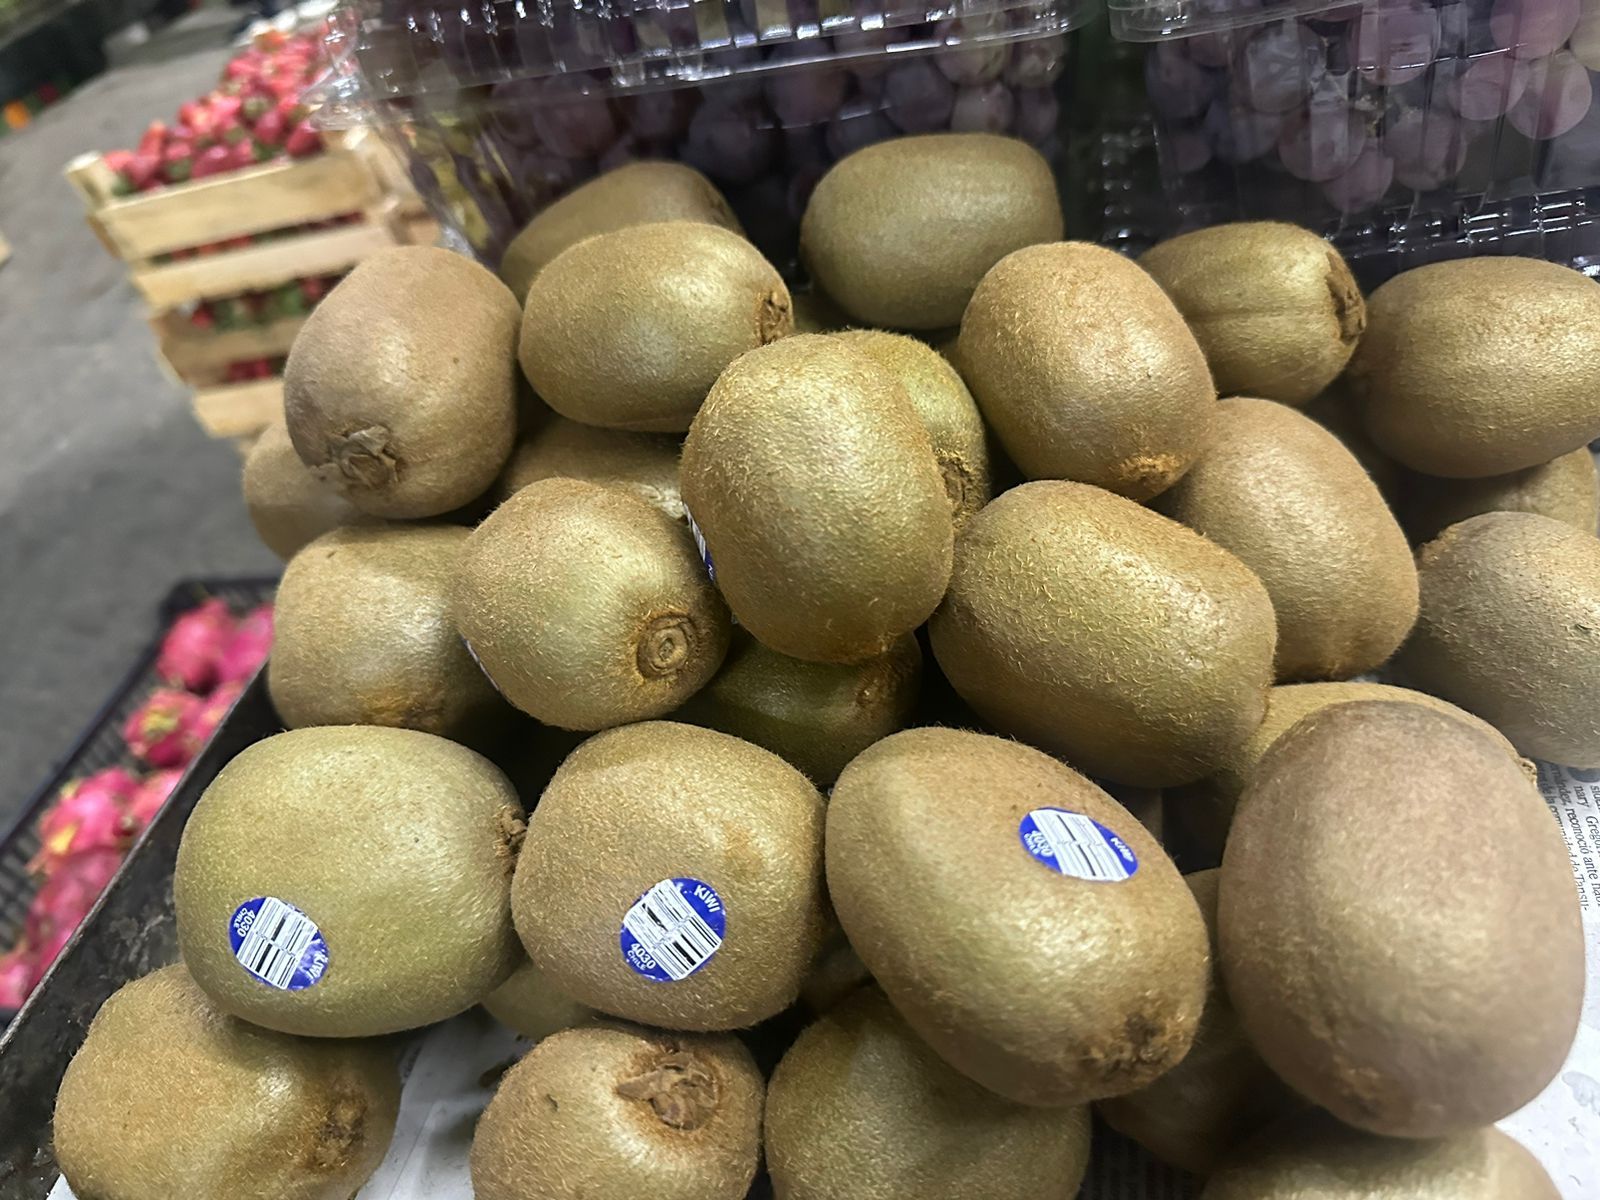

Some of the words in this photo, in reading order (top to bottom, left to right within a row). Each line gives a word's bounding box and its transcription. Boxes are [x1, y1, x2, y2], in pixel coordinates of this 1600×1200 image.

[1031, 829, 1054, 857] 4030
[1565, 808, 1594, 854] reconoció
[1583, 857, 1599, 880] ante
[693, 884, 721, 913] KIWI
[233, 907, 248, 928] CHILE
[237, 909, 256, 938] 4030
[627, 950, 647, 971] CHILE
[630, 942, 656, 970] 4030
